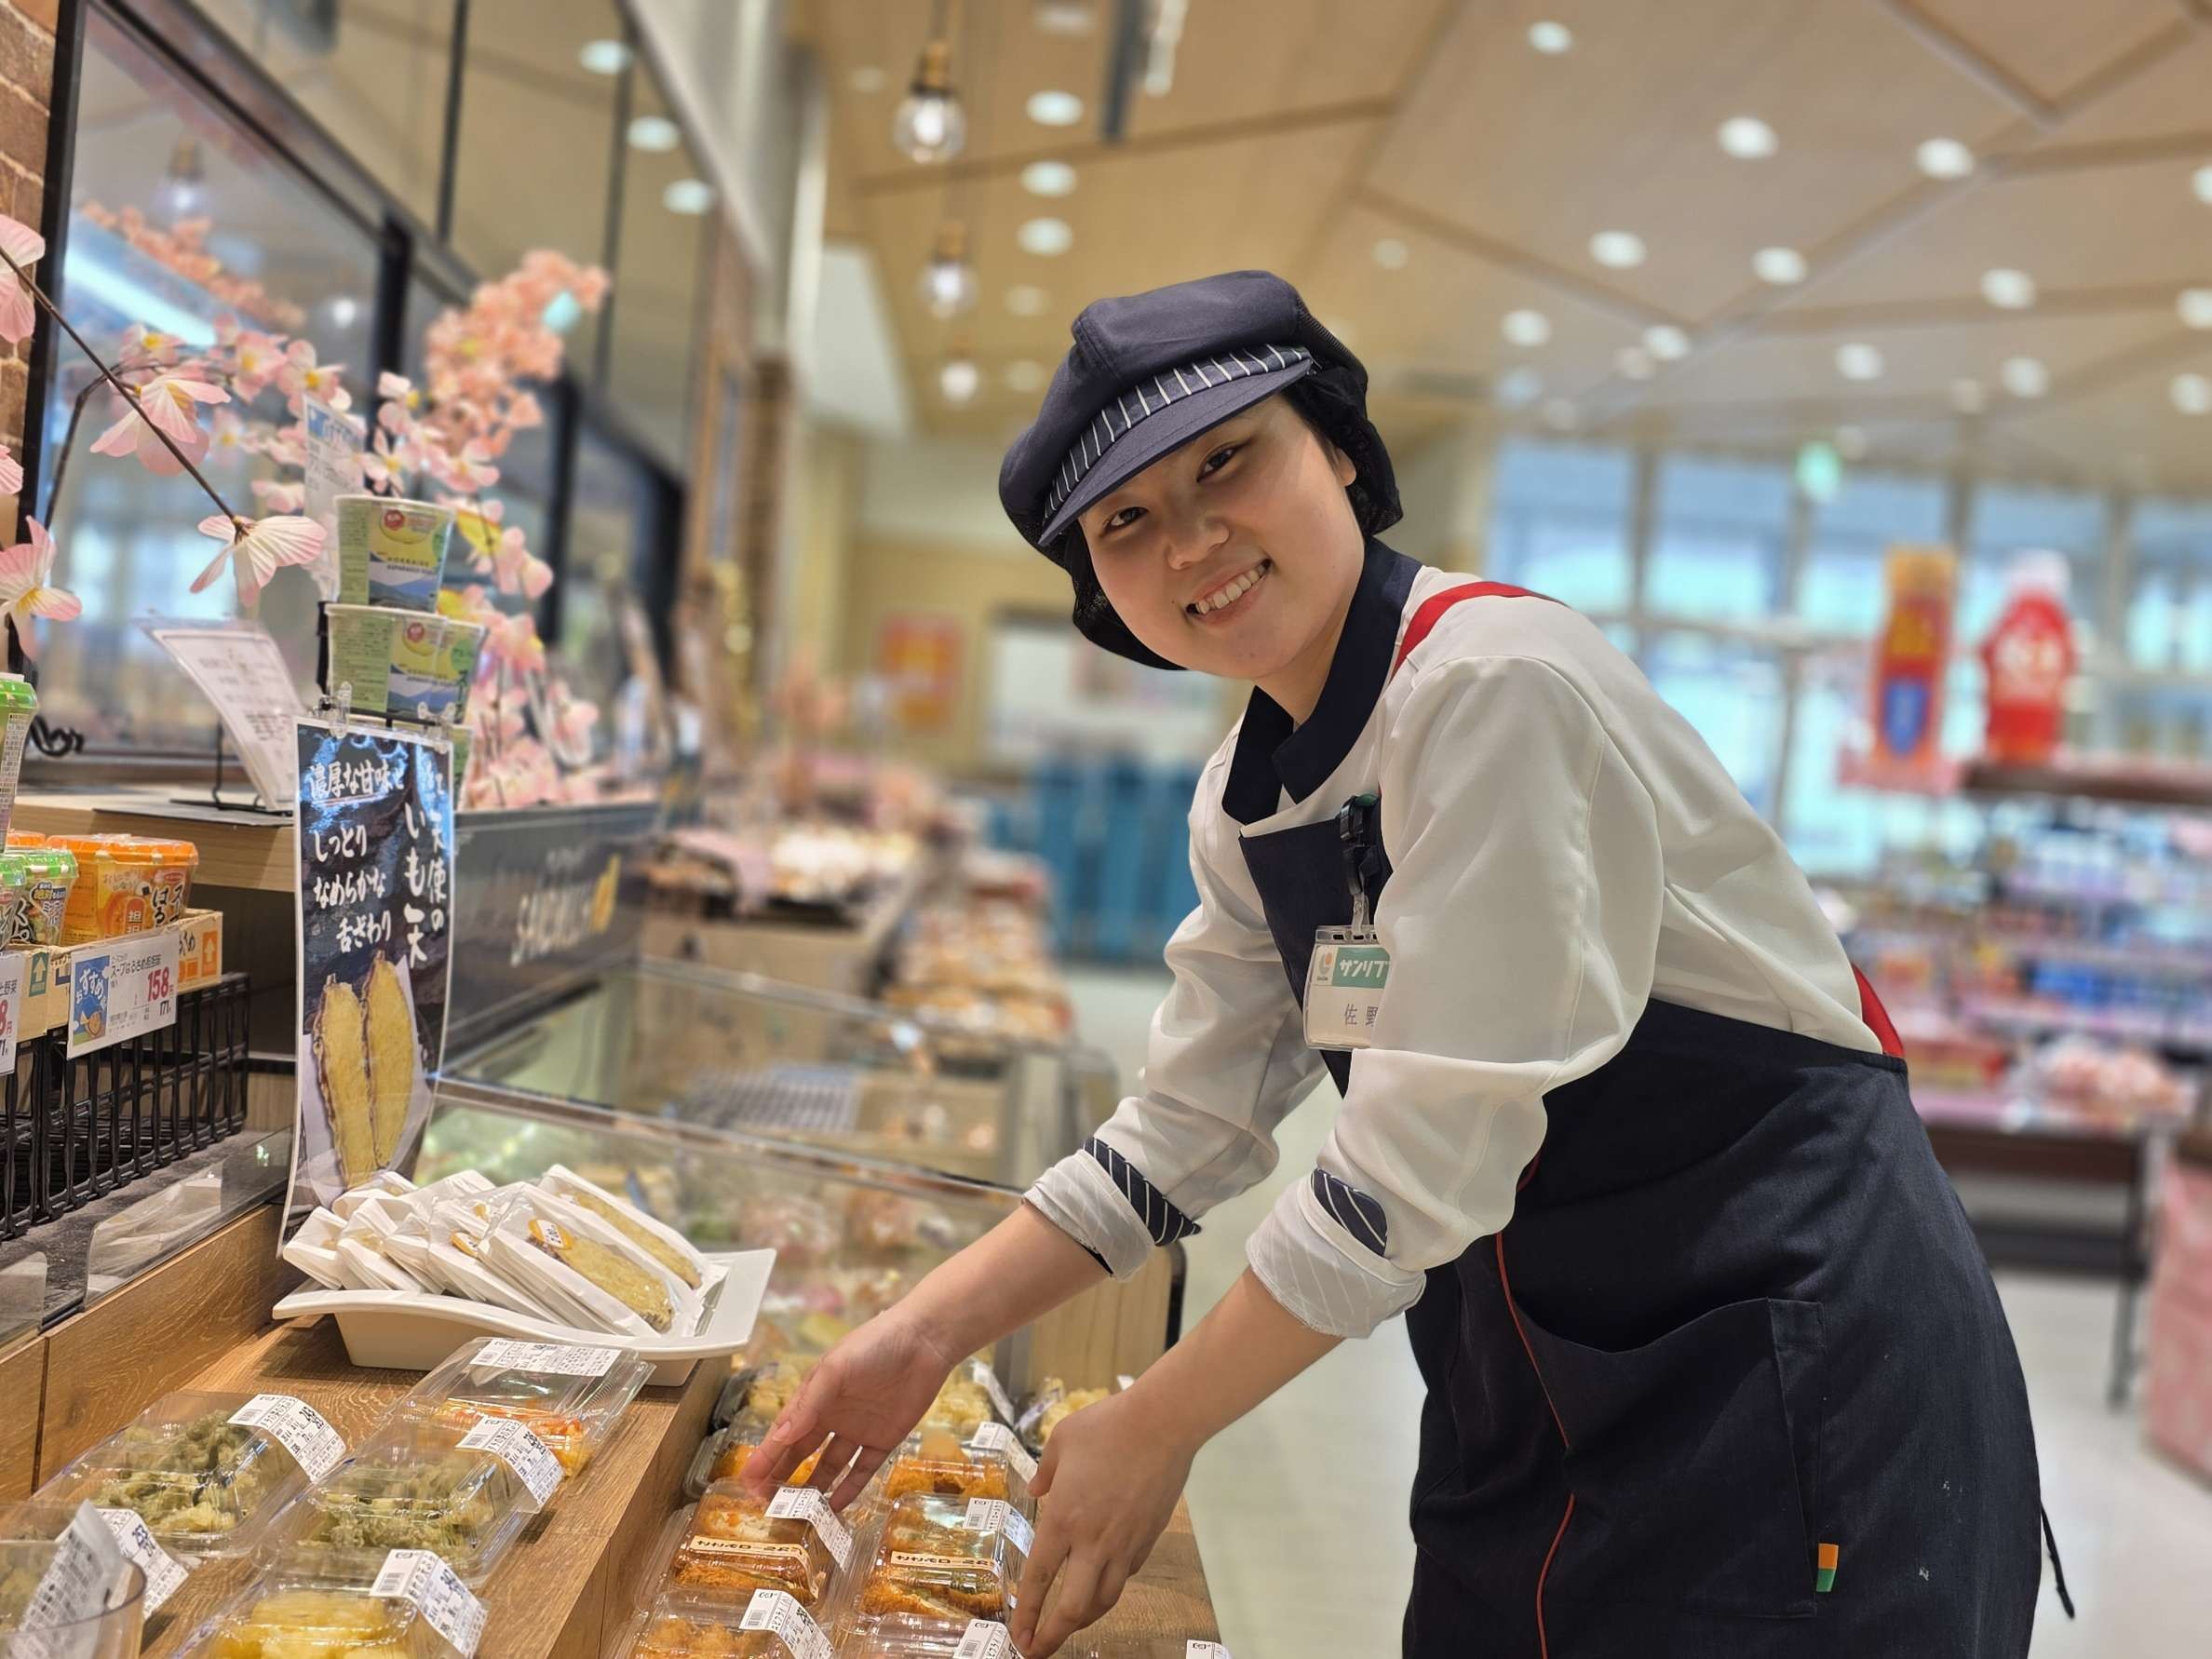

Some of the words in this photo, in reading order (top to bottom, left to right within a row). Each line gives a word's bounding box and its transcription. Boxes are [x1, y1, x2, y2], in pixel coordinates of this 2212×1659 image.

[310, 759, 405, 802] 濃厚な甘味と
[314, 824, 368, 863] しっとり
[313, 867, 387, 910] なめらかな
[403, 802, 428, 969] いも天
[336, 910, 392, 953] 舌ざわり
[147, 966, 170, 1003] 158
